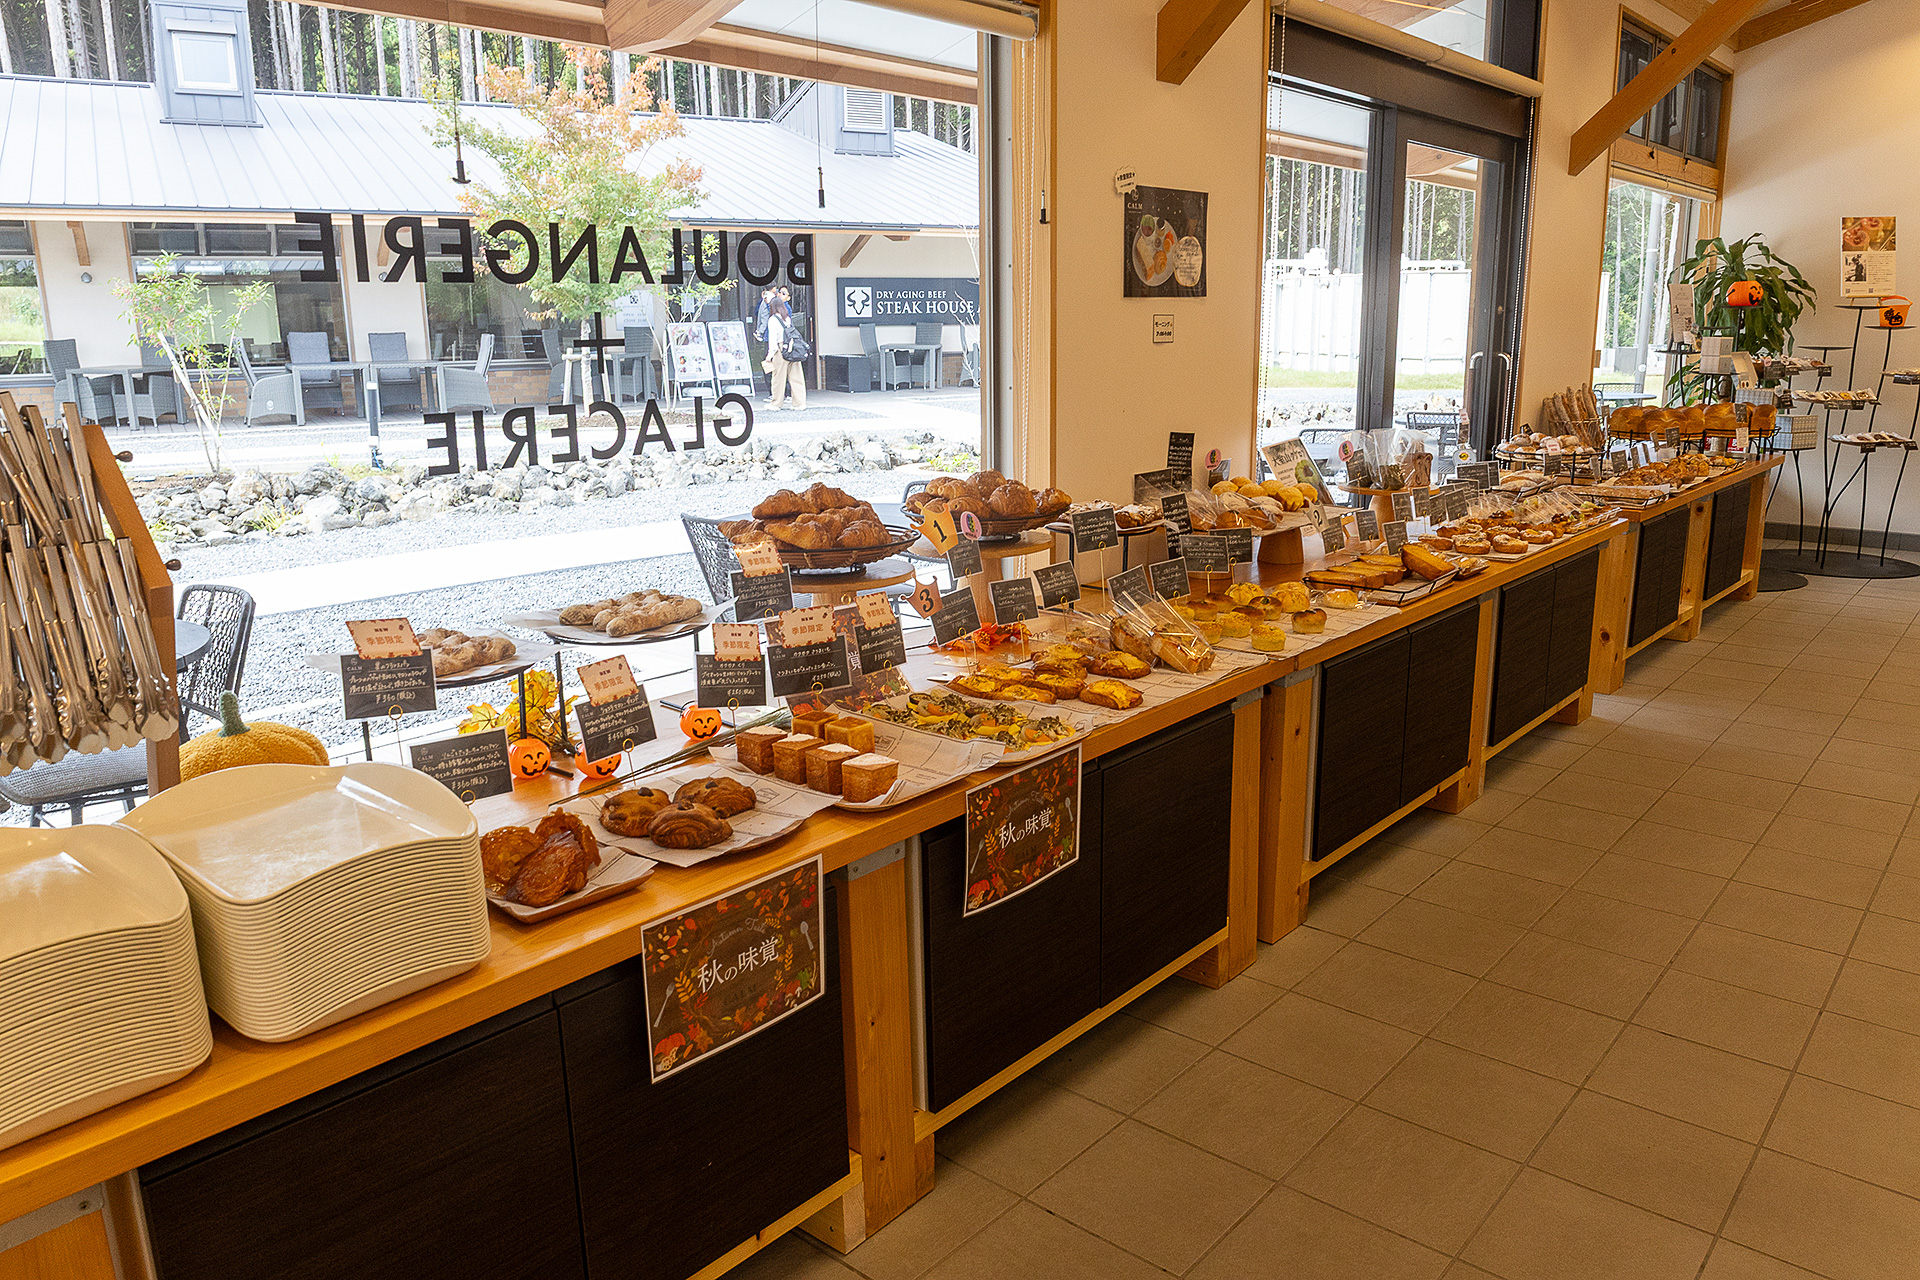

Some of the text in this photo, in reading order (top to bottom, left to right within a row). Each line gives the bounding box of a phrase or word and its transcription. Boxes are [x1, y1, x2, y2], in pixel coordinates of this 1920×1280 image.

[876, 290, 946, 298] DRY AGING BEEF
[876, 300, 974, 315] STEAK HOUSE
[1313, 509, 1323, 527] 2
[932, 519, 948, 544] 1
[919, 588, 935, 613] 3
[792, 624, 824, 636] 季節限定
[366, 634, 404, 646] 季節限定
[722, 640, 750, 650] 季節限定
[593, 675, 625, 692] 季節限定
[998, 807, 1052, 849] 秋の味覚
[706, 926, 744, 958] Autumn
[697, 936, 779, 994] 秋の味覚
